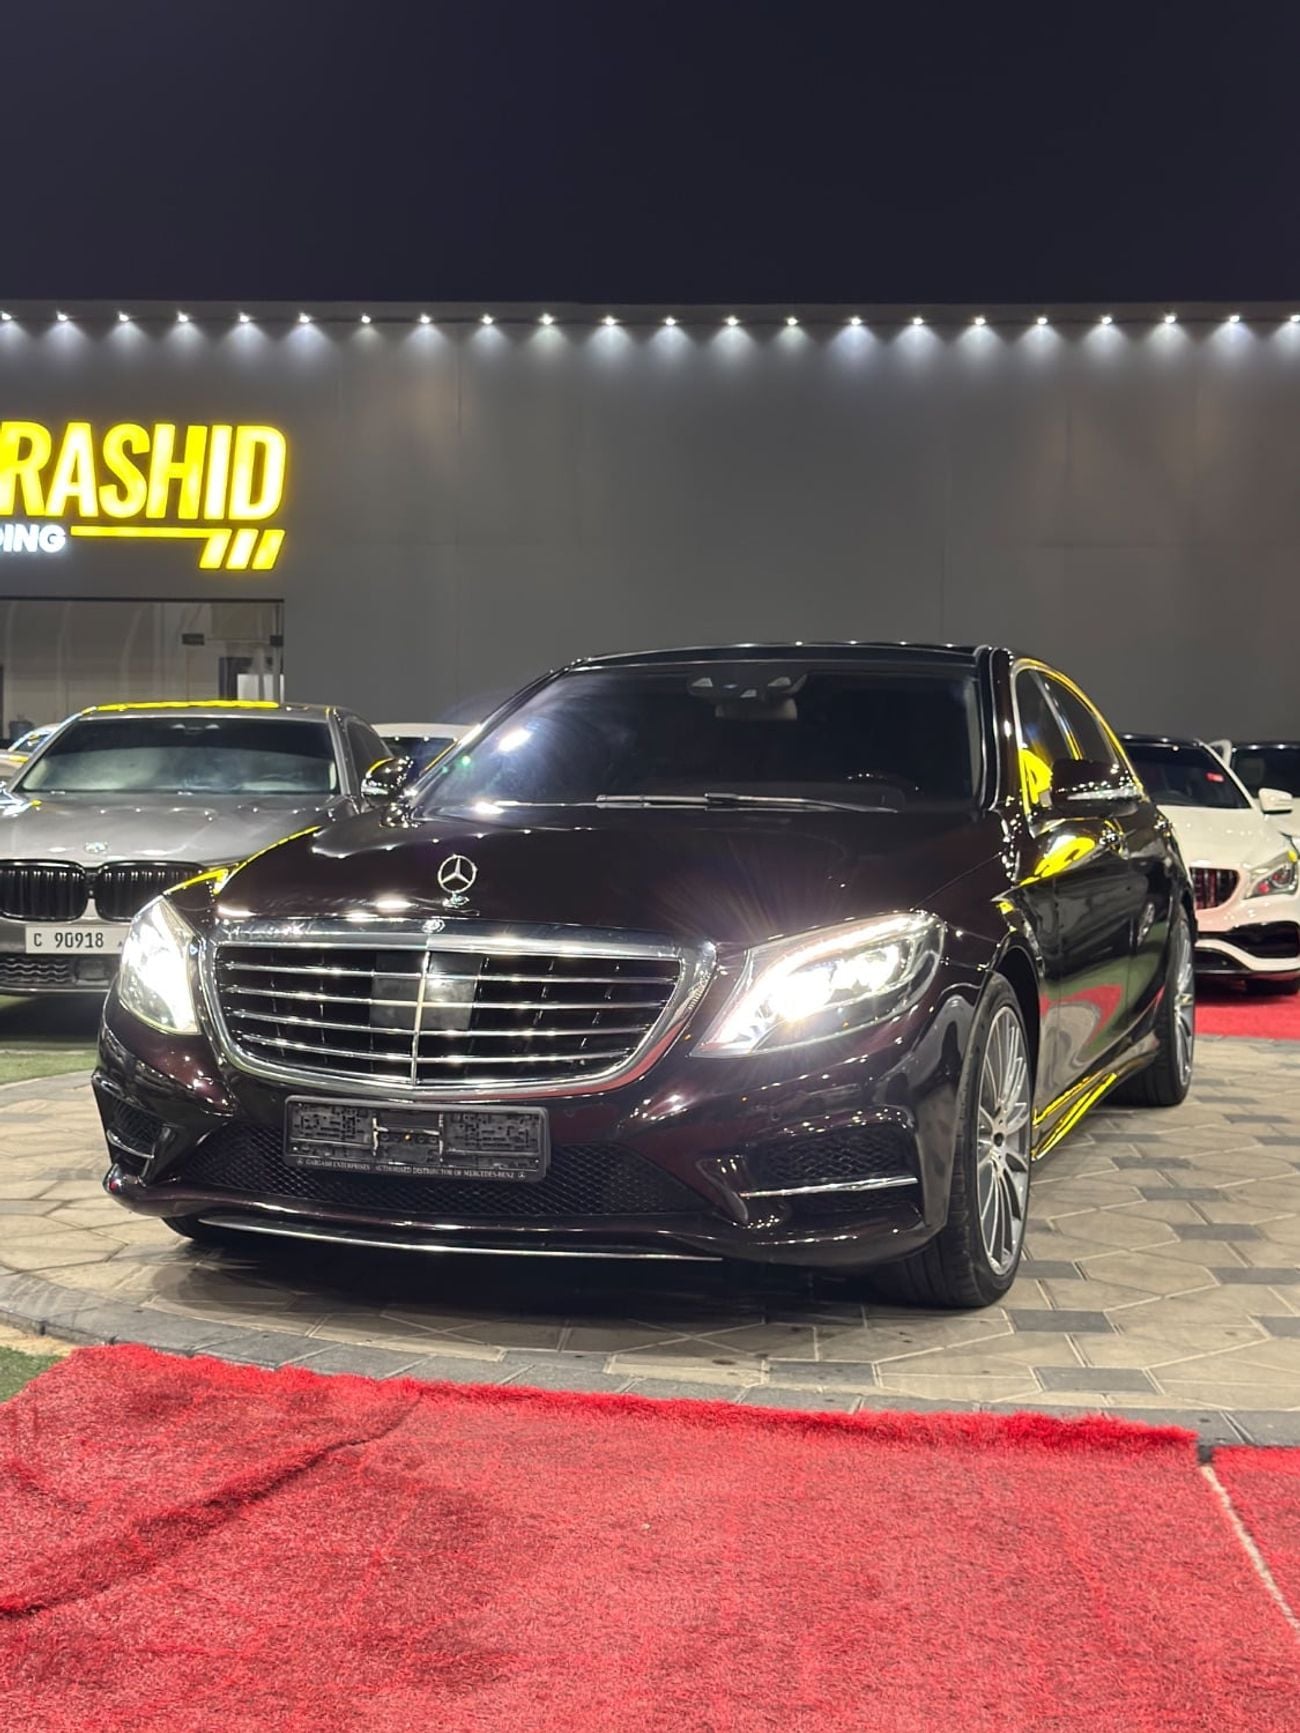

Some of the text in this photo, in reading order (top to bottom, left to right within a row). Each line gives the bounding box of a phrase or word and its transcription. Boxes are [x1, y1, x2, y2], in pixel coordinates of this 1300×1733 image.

[0, 421, 287, 520] RASHID
[0, 524, 66, 553] ING
[33, 932, 104, 949] C 90918
